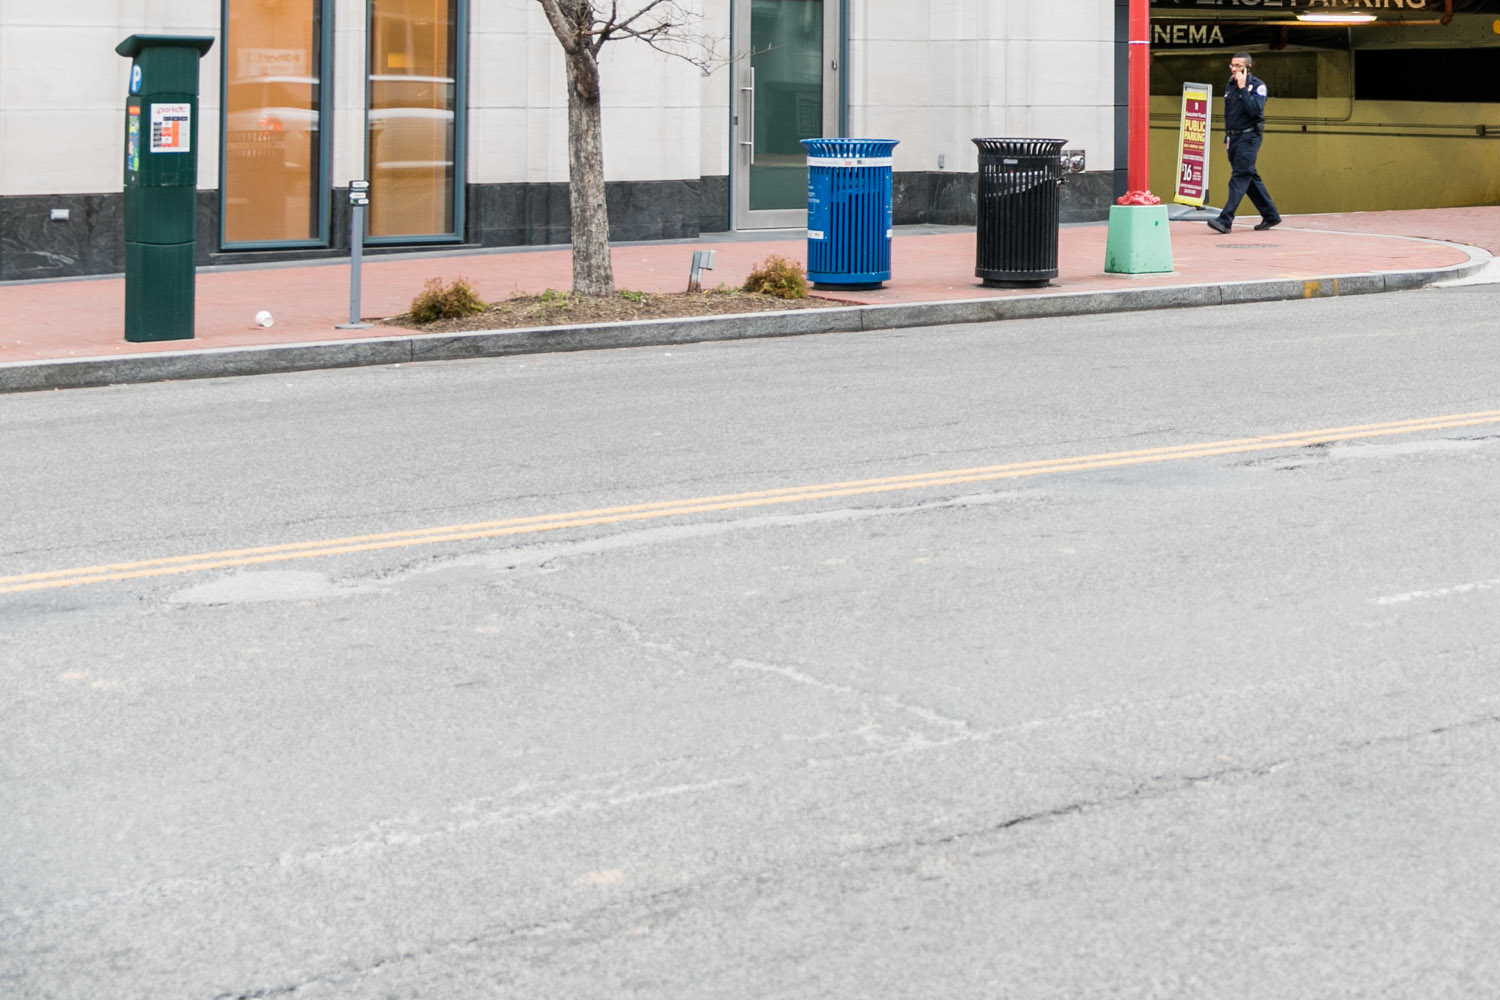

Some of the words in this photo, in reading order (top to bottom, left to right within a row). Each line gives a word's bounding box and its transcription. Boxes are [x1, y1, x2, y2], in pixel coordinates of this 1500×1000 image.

[131, 65, 141, 92] P
[1185, 119, 1205, 132] PUBLIC
[1184, 131, 1205, 143] PARKING
